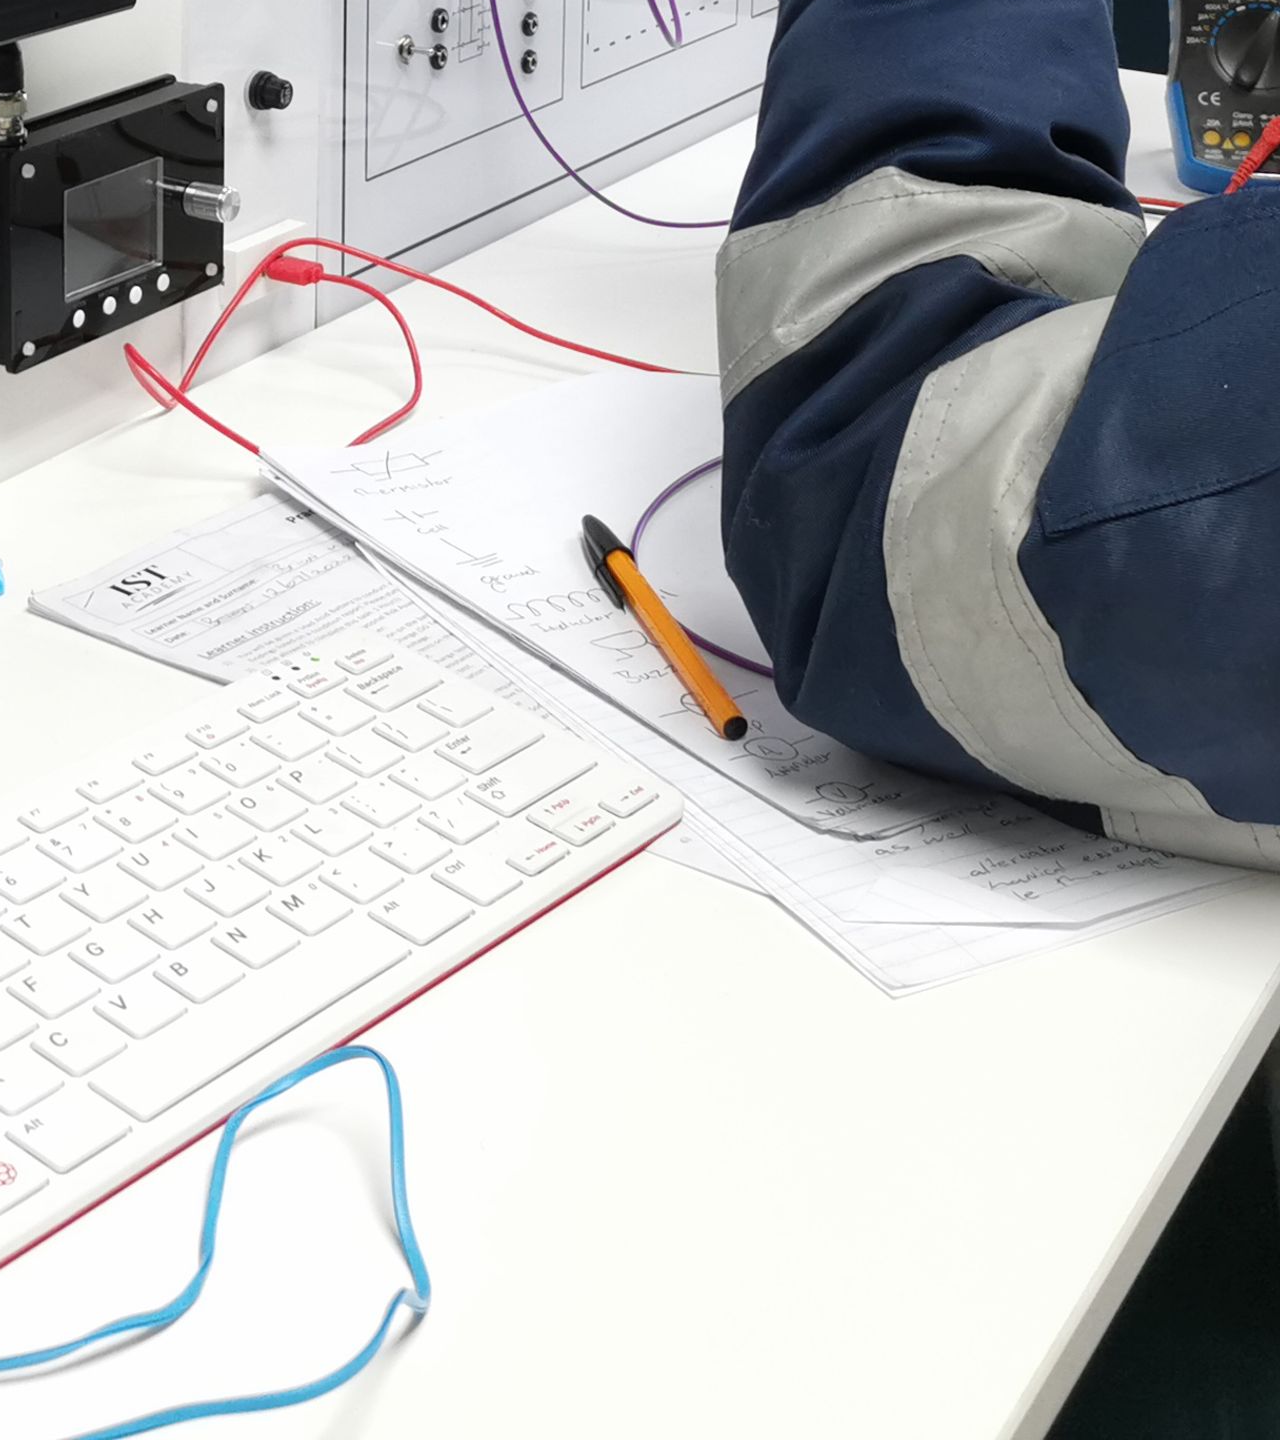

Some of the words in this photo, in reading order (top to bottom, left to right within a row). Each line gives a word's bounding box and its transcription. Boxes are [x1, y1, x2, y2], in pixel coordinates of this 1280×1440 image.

[109, 564, 166, 596] IST
[120, 570, 192, 610] ACADEMY
[197, 634, 252, 660] Learner
[245, 599, 322, 638] instruction:
[356, 665, 404, 690] Backspace
[444, 734, 471, 750] Enter
[288, 770, 303, 784] P
[476, 776, 502, 792] Shift
[172, 790, 185, 799] 9
[239, 796, 257, 809] O
[118, 816, 132, 827] 8
[304, 823, 322, 834] L
[185, 827, 198, 839] I
[874, 843, 911, 857] as
[922, 823, 971, 846] well
[61, 845, 73, 856] 7
[252, 848, 272, 863] K
[130, 852, 150, 866] U
[444, 859, 466, 874] Ctrl
[4, 876, 17, 886] 6
[203, 878, 216, 893] J
[73, 882, 90, 896] Y
[280, 894, 305, 912] M
[382, 900, 400, 914] Alt
[13, 914, 31, 928] T
[142, 908, 164, 924] H
[226, 927, 248, 944] N
[85, 942, 105, 956] G
[169, 962, 189, 977] B
[22, 976, 36, 992] F
[108, 994, 128, 1010] V
[48, 1032, 68, 1047] C
[23, 1118, 44, 1134] Alt
